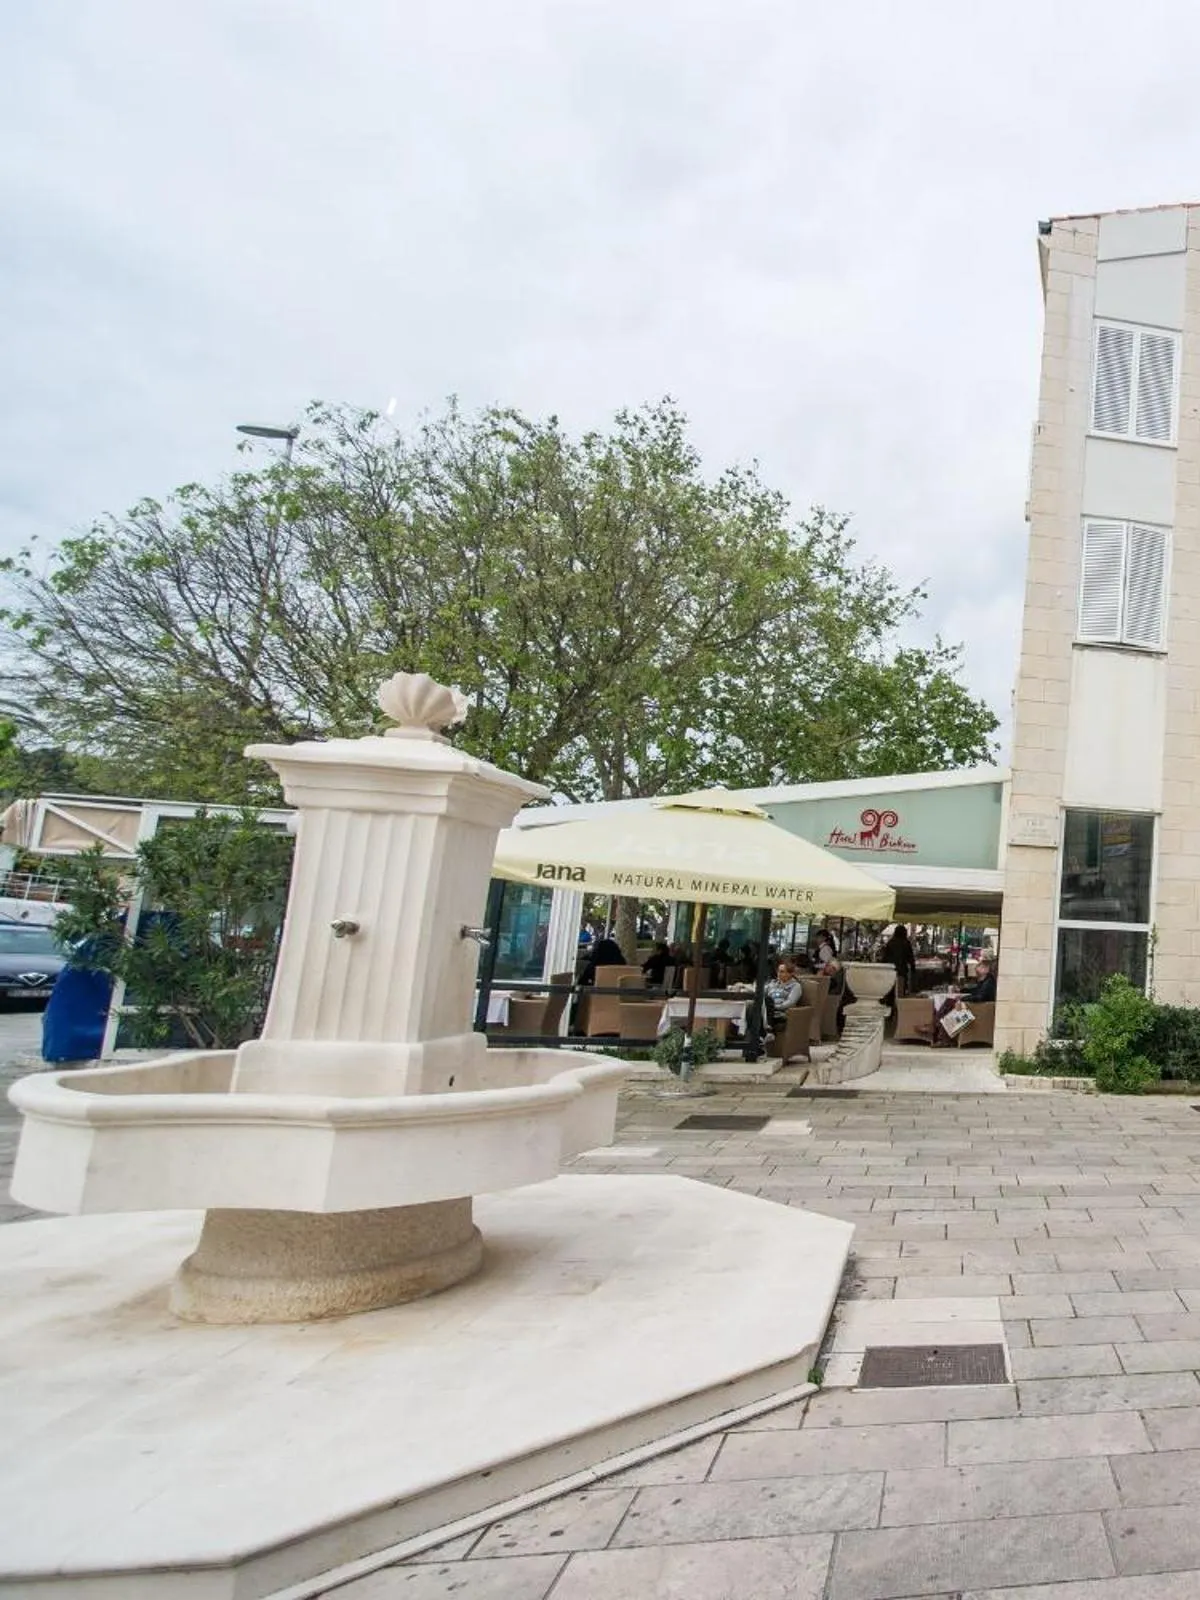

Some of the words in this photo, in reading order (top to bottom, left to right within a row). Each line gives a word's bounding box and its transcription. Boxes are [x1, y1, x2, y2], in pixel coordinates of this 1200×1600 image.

[612, 872, 684, 891] NATURAL
[690, 881, 758, 898] MINERAL
[766, 888, 815, 903] WATER
